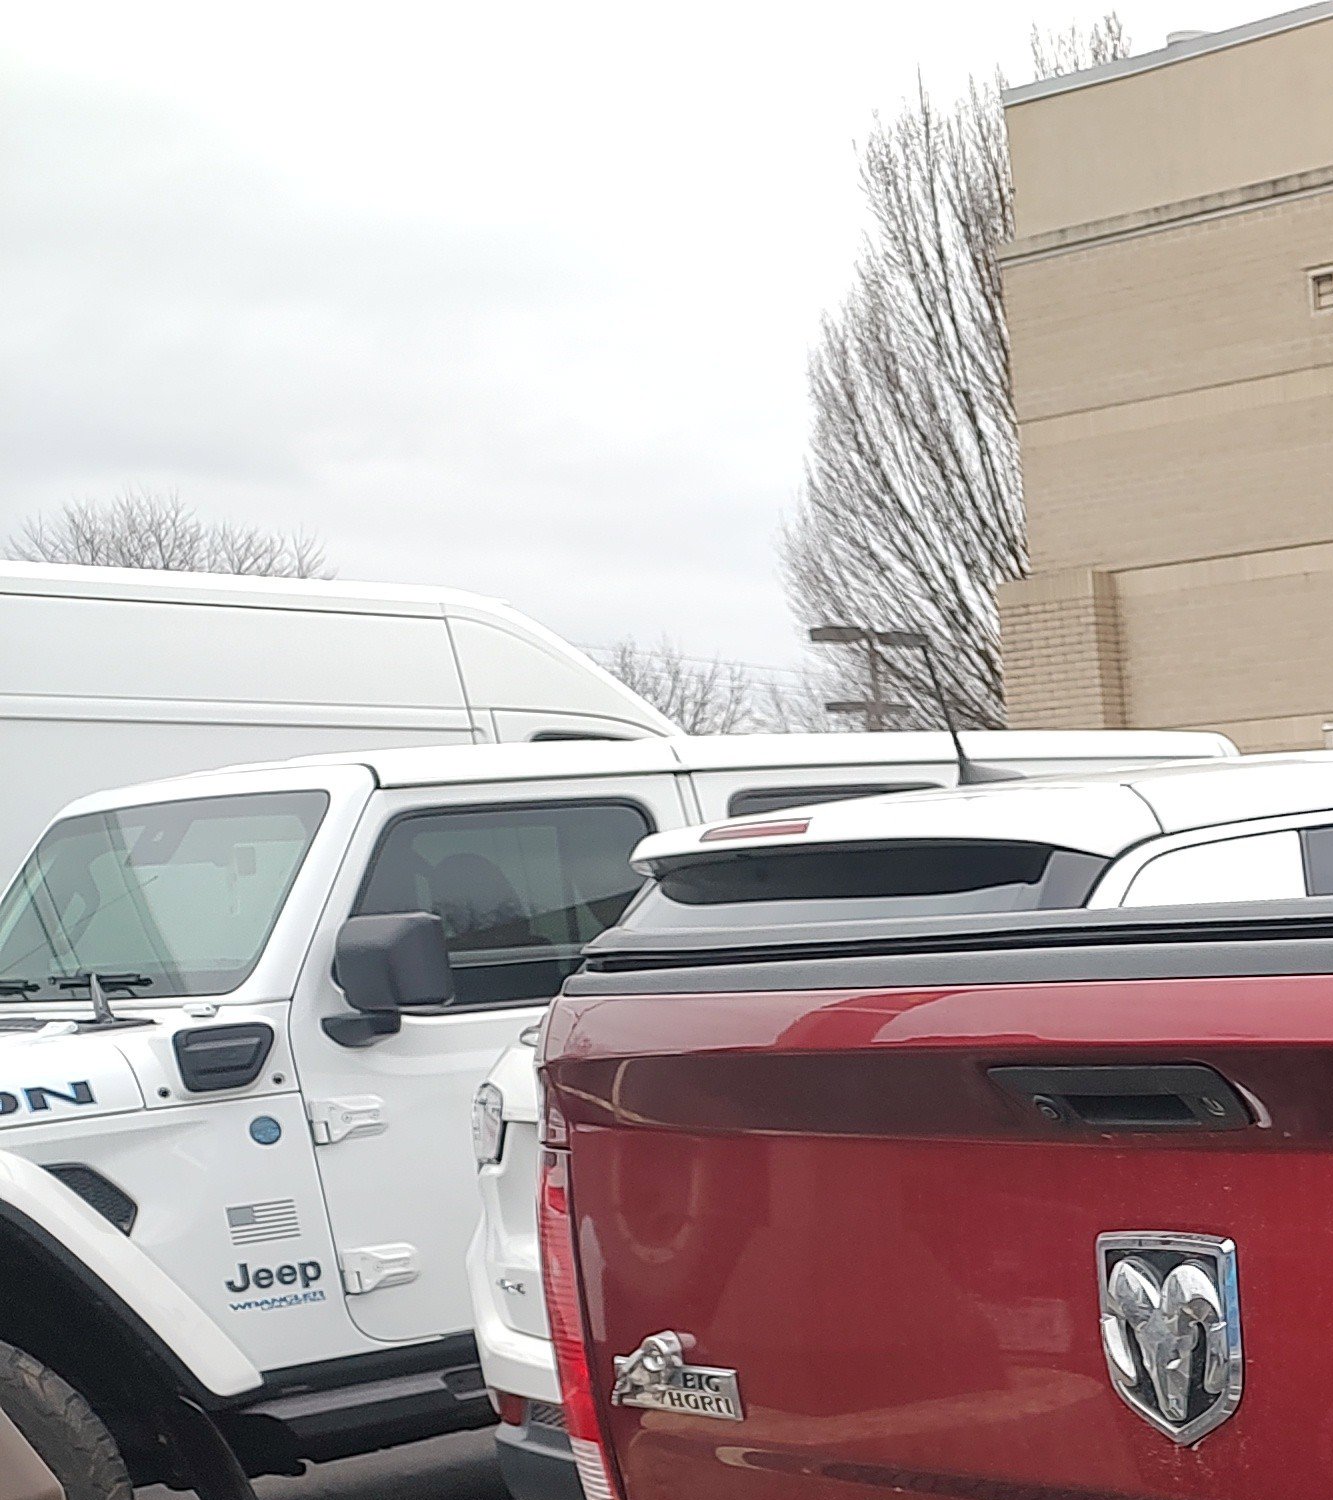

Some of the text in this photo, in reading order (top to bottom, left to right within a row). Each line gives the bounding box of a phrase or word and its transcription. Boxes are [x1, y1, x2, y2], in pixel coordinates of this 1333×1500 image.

[0, 1080, 97, 1115] N
[225, 1260, 322, 1293] Jeep
[683, 1372, 722, 1395] BIG
[667, 1391, 736, 1415] HORN
